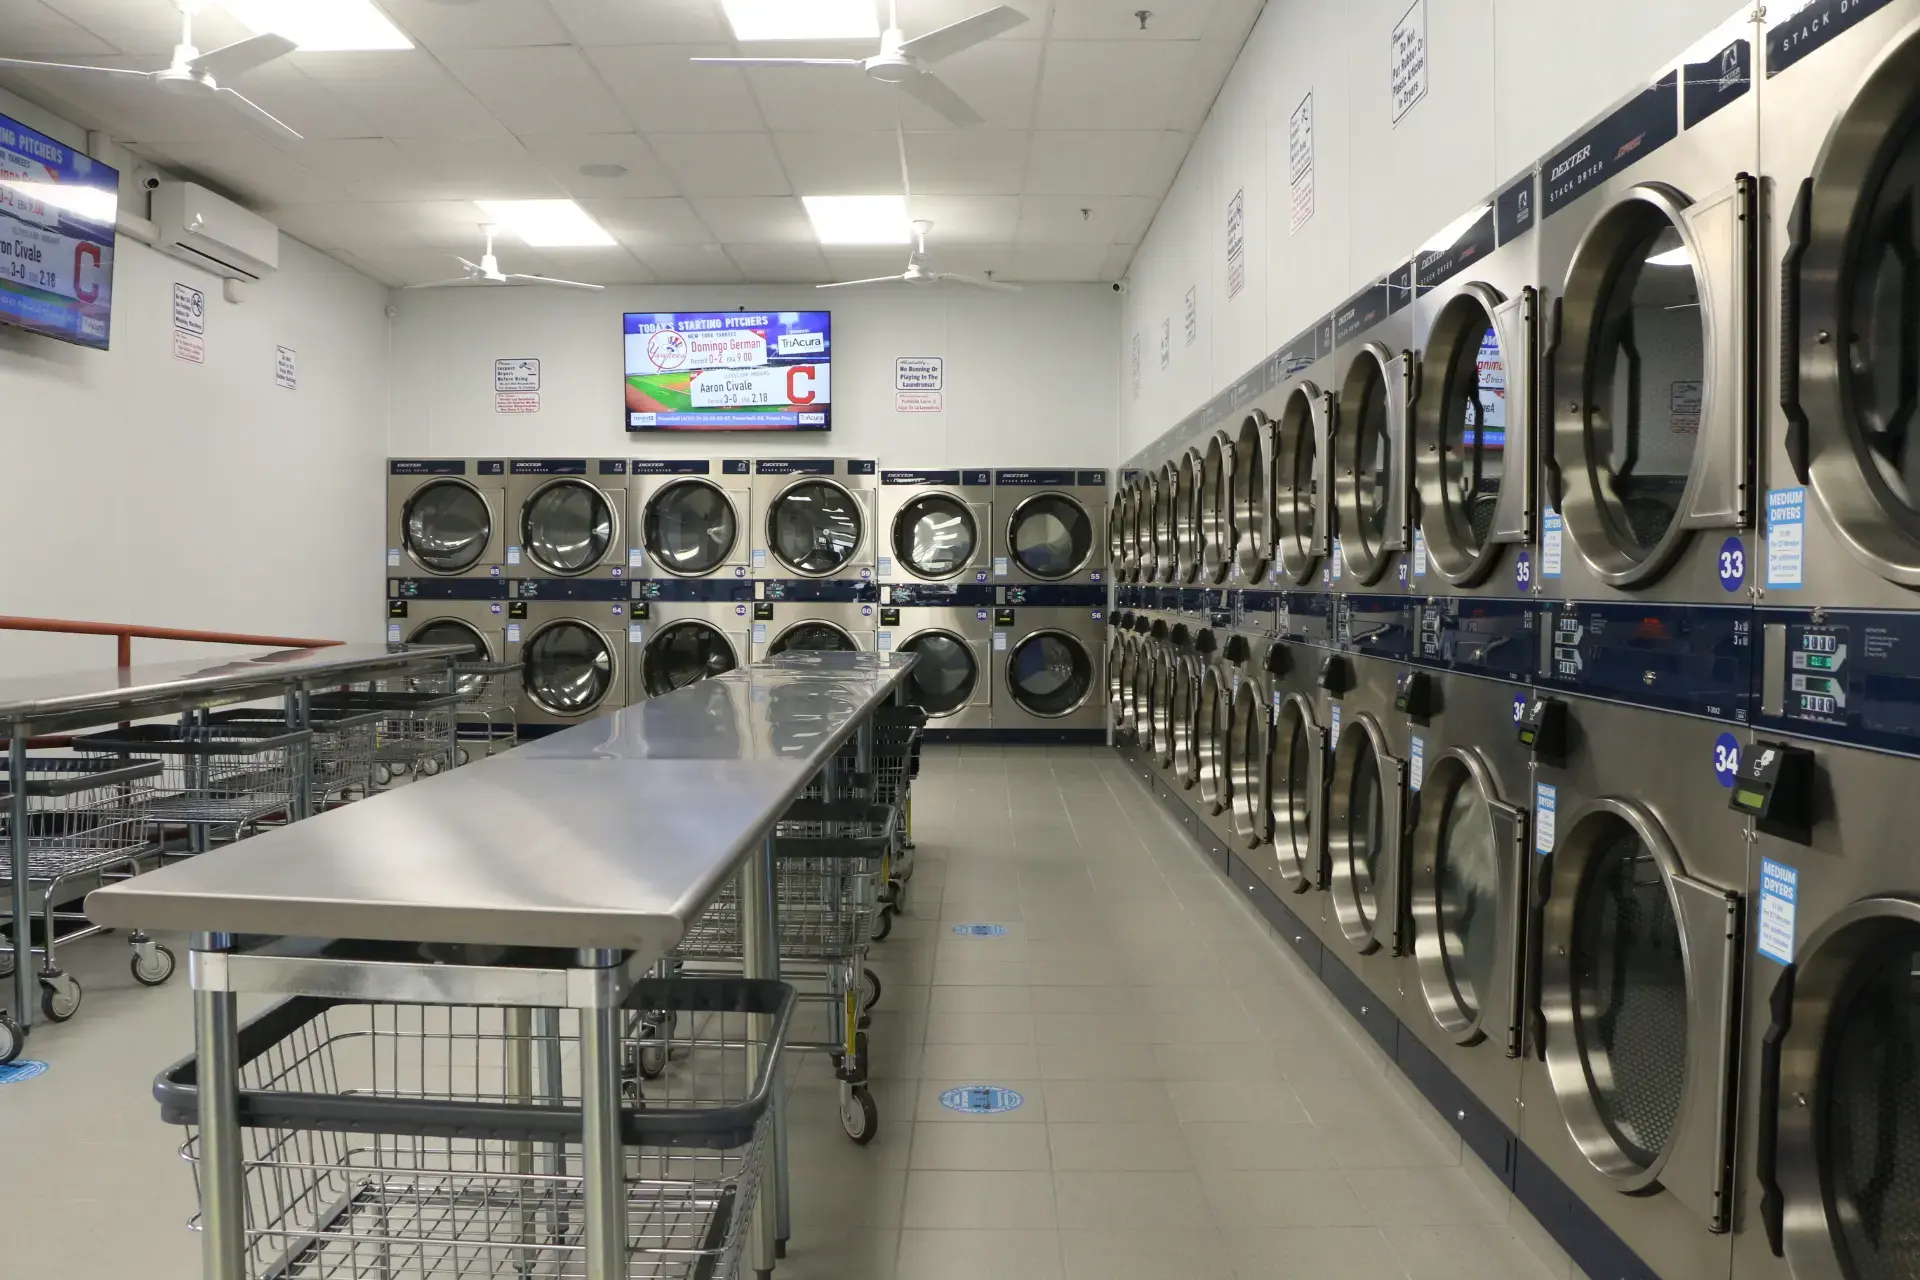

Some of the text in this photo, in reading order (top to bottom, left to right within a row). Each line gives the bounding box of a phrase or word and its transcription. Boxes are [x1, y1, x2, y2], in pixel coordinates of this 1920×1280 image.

[1783, 11, 1830, 51] STACK
[19, 134, 63, 164] PITCHERS
[1551, 144, 1591, 182] DEXTER
[1550, 161, 1603, 202] STACK DRYER
[15, 240, 42, 263] Civale
[11, 261, 56, 288] 3-0 2.18
[638, 316, 768, 334] TODAY'S STARTING PITCHERS
[691, 339, 761, 353] Domingo German
[781, 338, 821, 348] TriAcura
[709, 353, 723, 364] 0-2
[700, 380, 753, 393] Aaron Civale
[787, 366, 816, 405] C
[724, 393, 738, 403] 3-0
[752, 393, 768, 403] 2.18
[1769, 491, 1803, 506] MEDIUM
[1771, 506, 1801, 521] DRYERS
[612, 568, 621, 576] 63
[735, 568, 746, 576] 61
[1398, 564, 1408, 581] 37
[1516, 561, 1530, 582] 35
[1720, 550, 1744, 579] 33
[612, 606, 622, 614] 64
[861, 607, 872, 615] 60
[977, 612, 987, 620] 58
[1715, 745, 1738, 775] 34
[1763, 861, 1796, 885] MEDIUM
[1764, 876, 1794, 900] DRYERS
